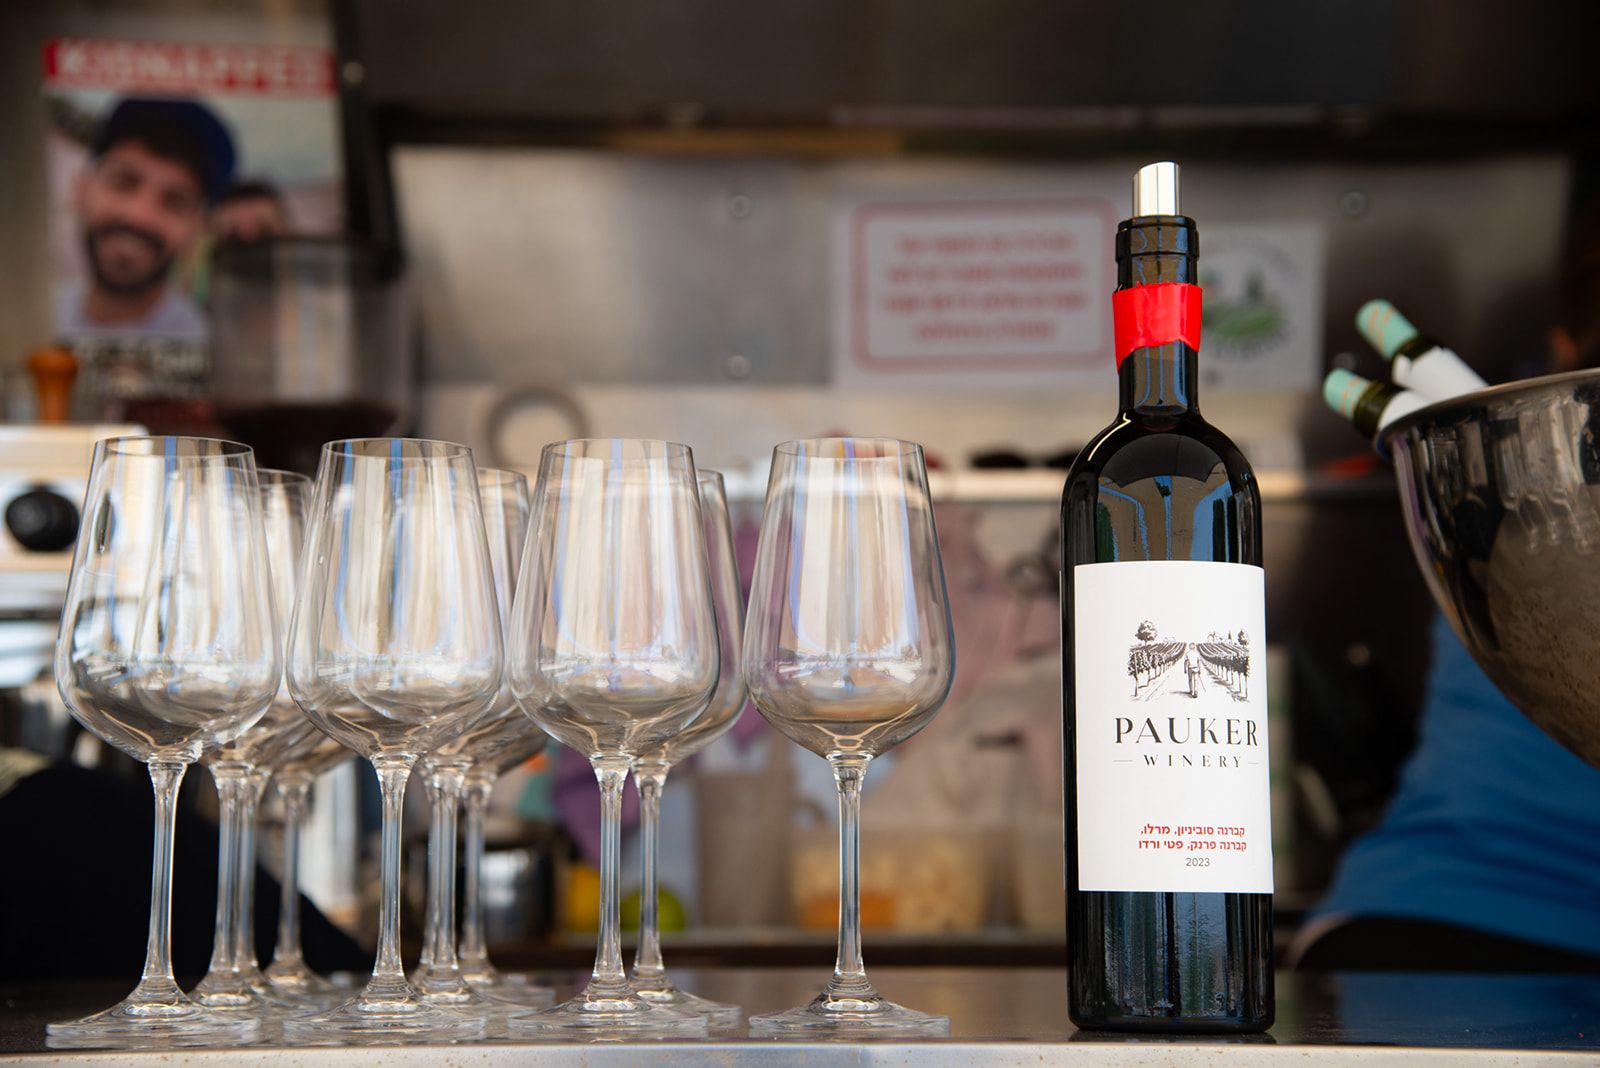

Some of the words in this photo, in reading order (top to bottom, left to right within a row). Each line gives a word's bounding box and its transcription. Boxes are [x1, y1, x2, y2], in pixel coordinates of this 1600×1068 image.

[1114, 717, 1258, 747] PAUKER
[1143, 754, 1241, 768] WINERY
[1140, 824, 1170, 836] מרלו,
[1217, 827, 1245, 837] קברנה
[1138, 840, 1160, 849] ורדו
[1163, 840, 1184, 849] פטי
[1187, 841, 1217, 851] פרנק,
[1219, 841, 1247, 852] קברנה
[1185, 857, 1210, 867] 2023
